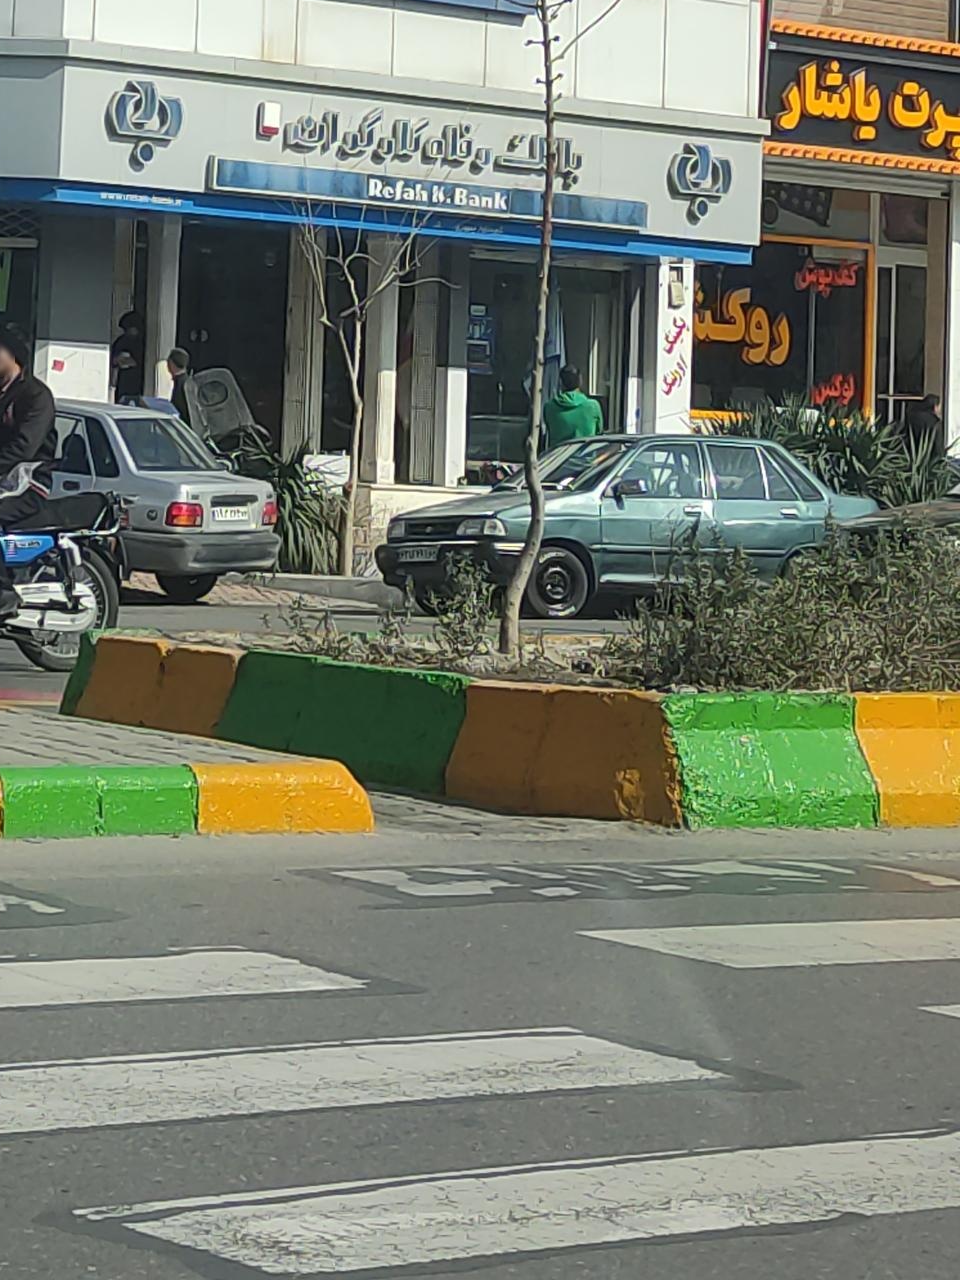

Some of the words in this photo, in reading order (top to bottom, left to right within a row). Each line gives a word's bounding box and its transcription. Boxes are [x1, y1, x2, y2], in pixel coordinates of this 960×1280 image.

[776, 60, 881, 140] یاشار
[282, 108, 429, 163] کارگران
[421, 121, 493, 175] رفاه
[493, 132, 584, 190] باک
[368, 178, 428, 202] Refah
[454, 187, 508, 210] Bank
[811, 372, 856, 406] لوکس
